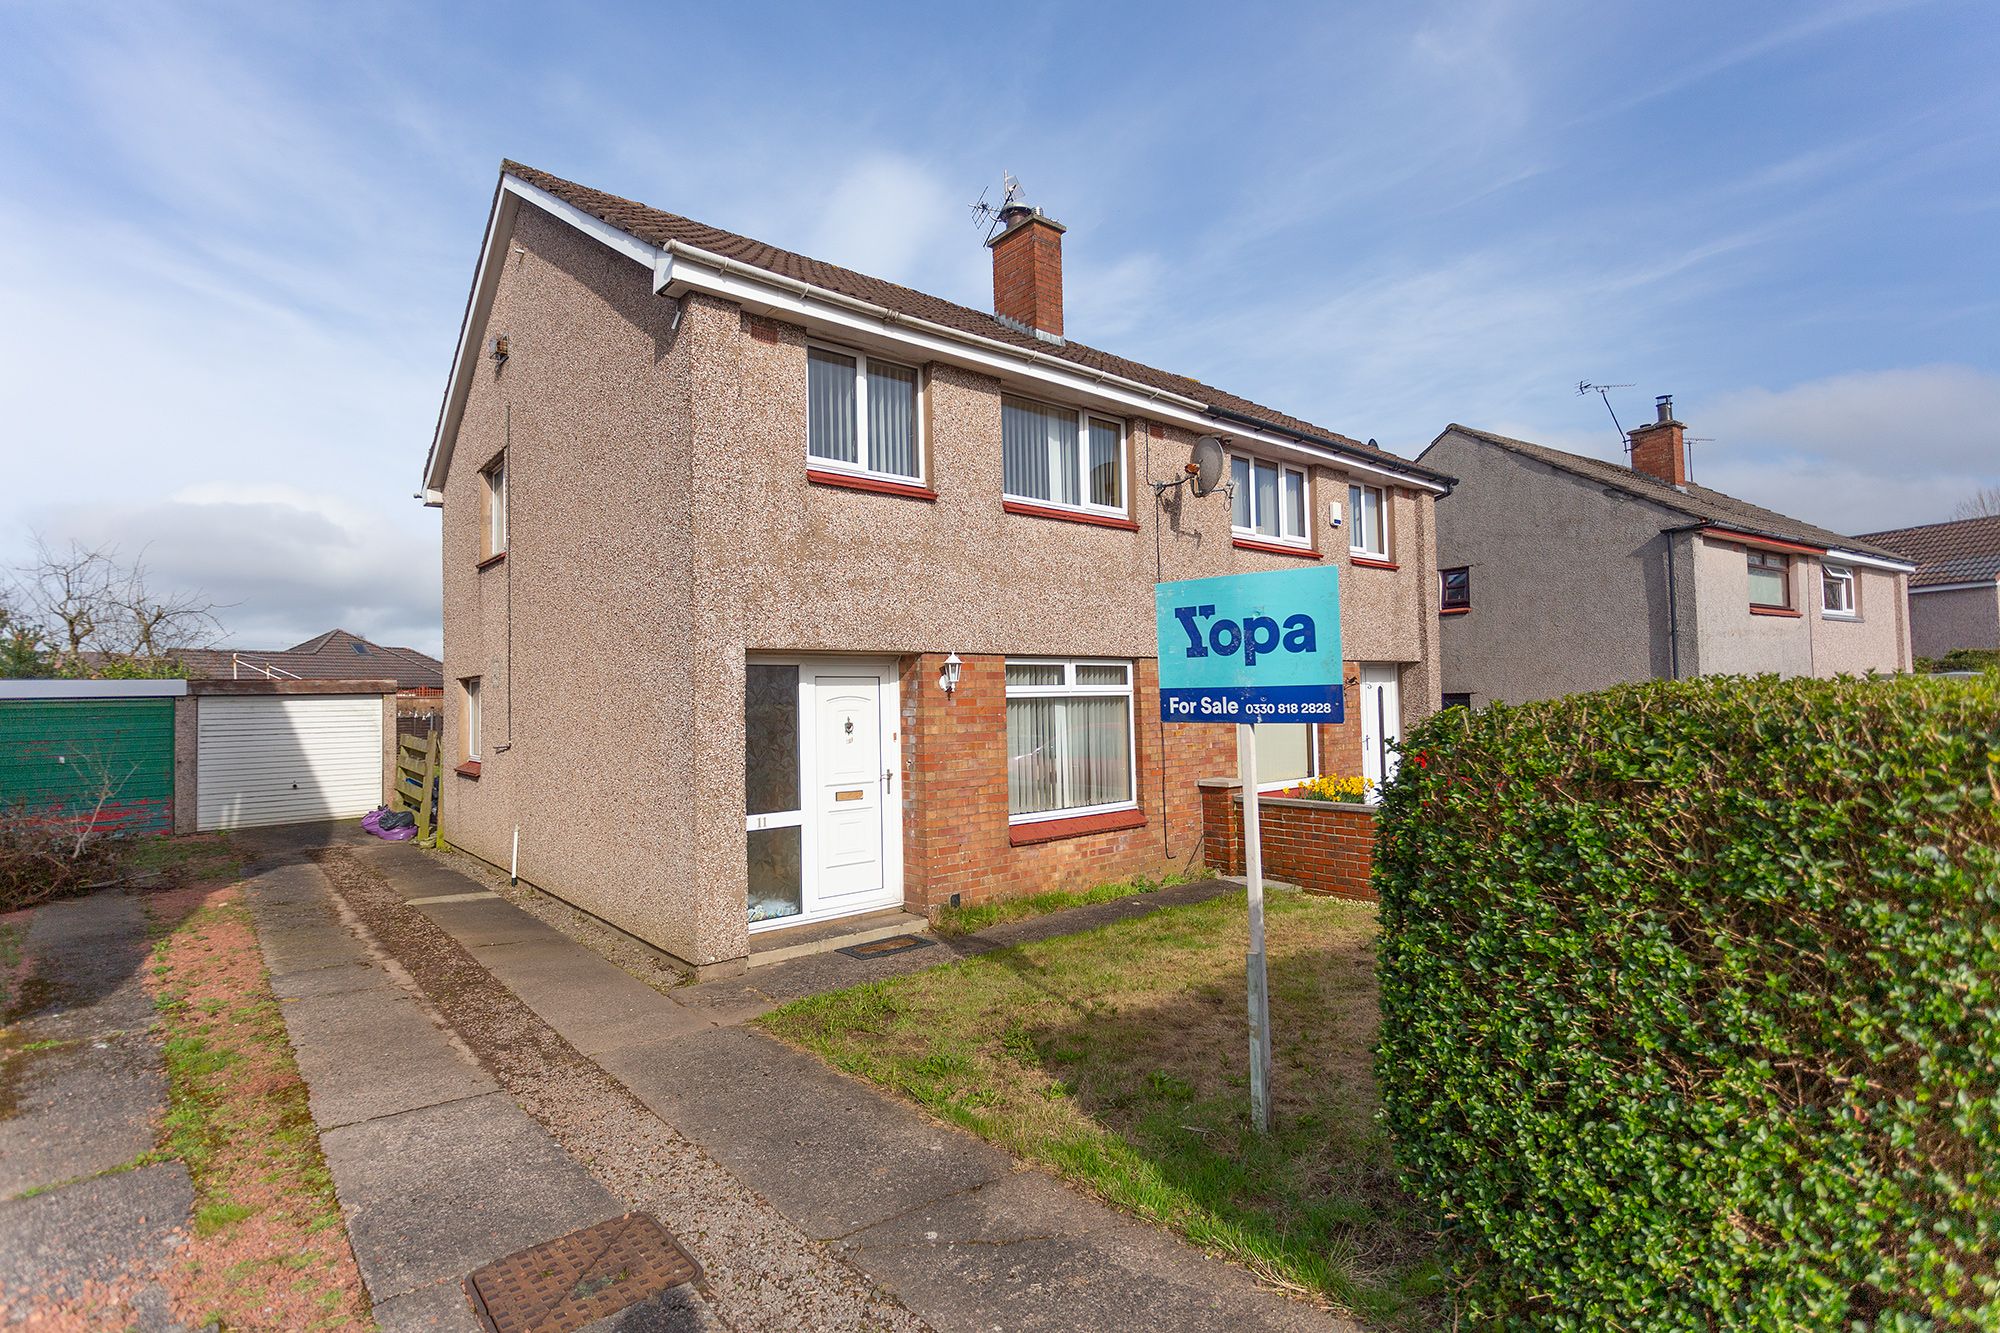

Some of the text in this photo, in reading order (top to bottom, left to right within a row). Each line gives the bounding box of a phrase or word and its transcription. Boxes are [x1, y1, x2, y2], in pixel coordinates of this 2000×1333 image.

[1174, 604, 1317, 667] Yopa
[1169, 696, 1332, 714] For Sale 0330 818 2828
